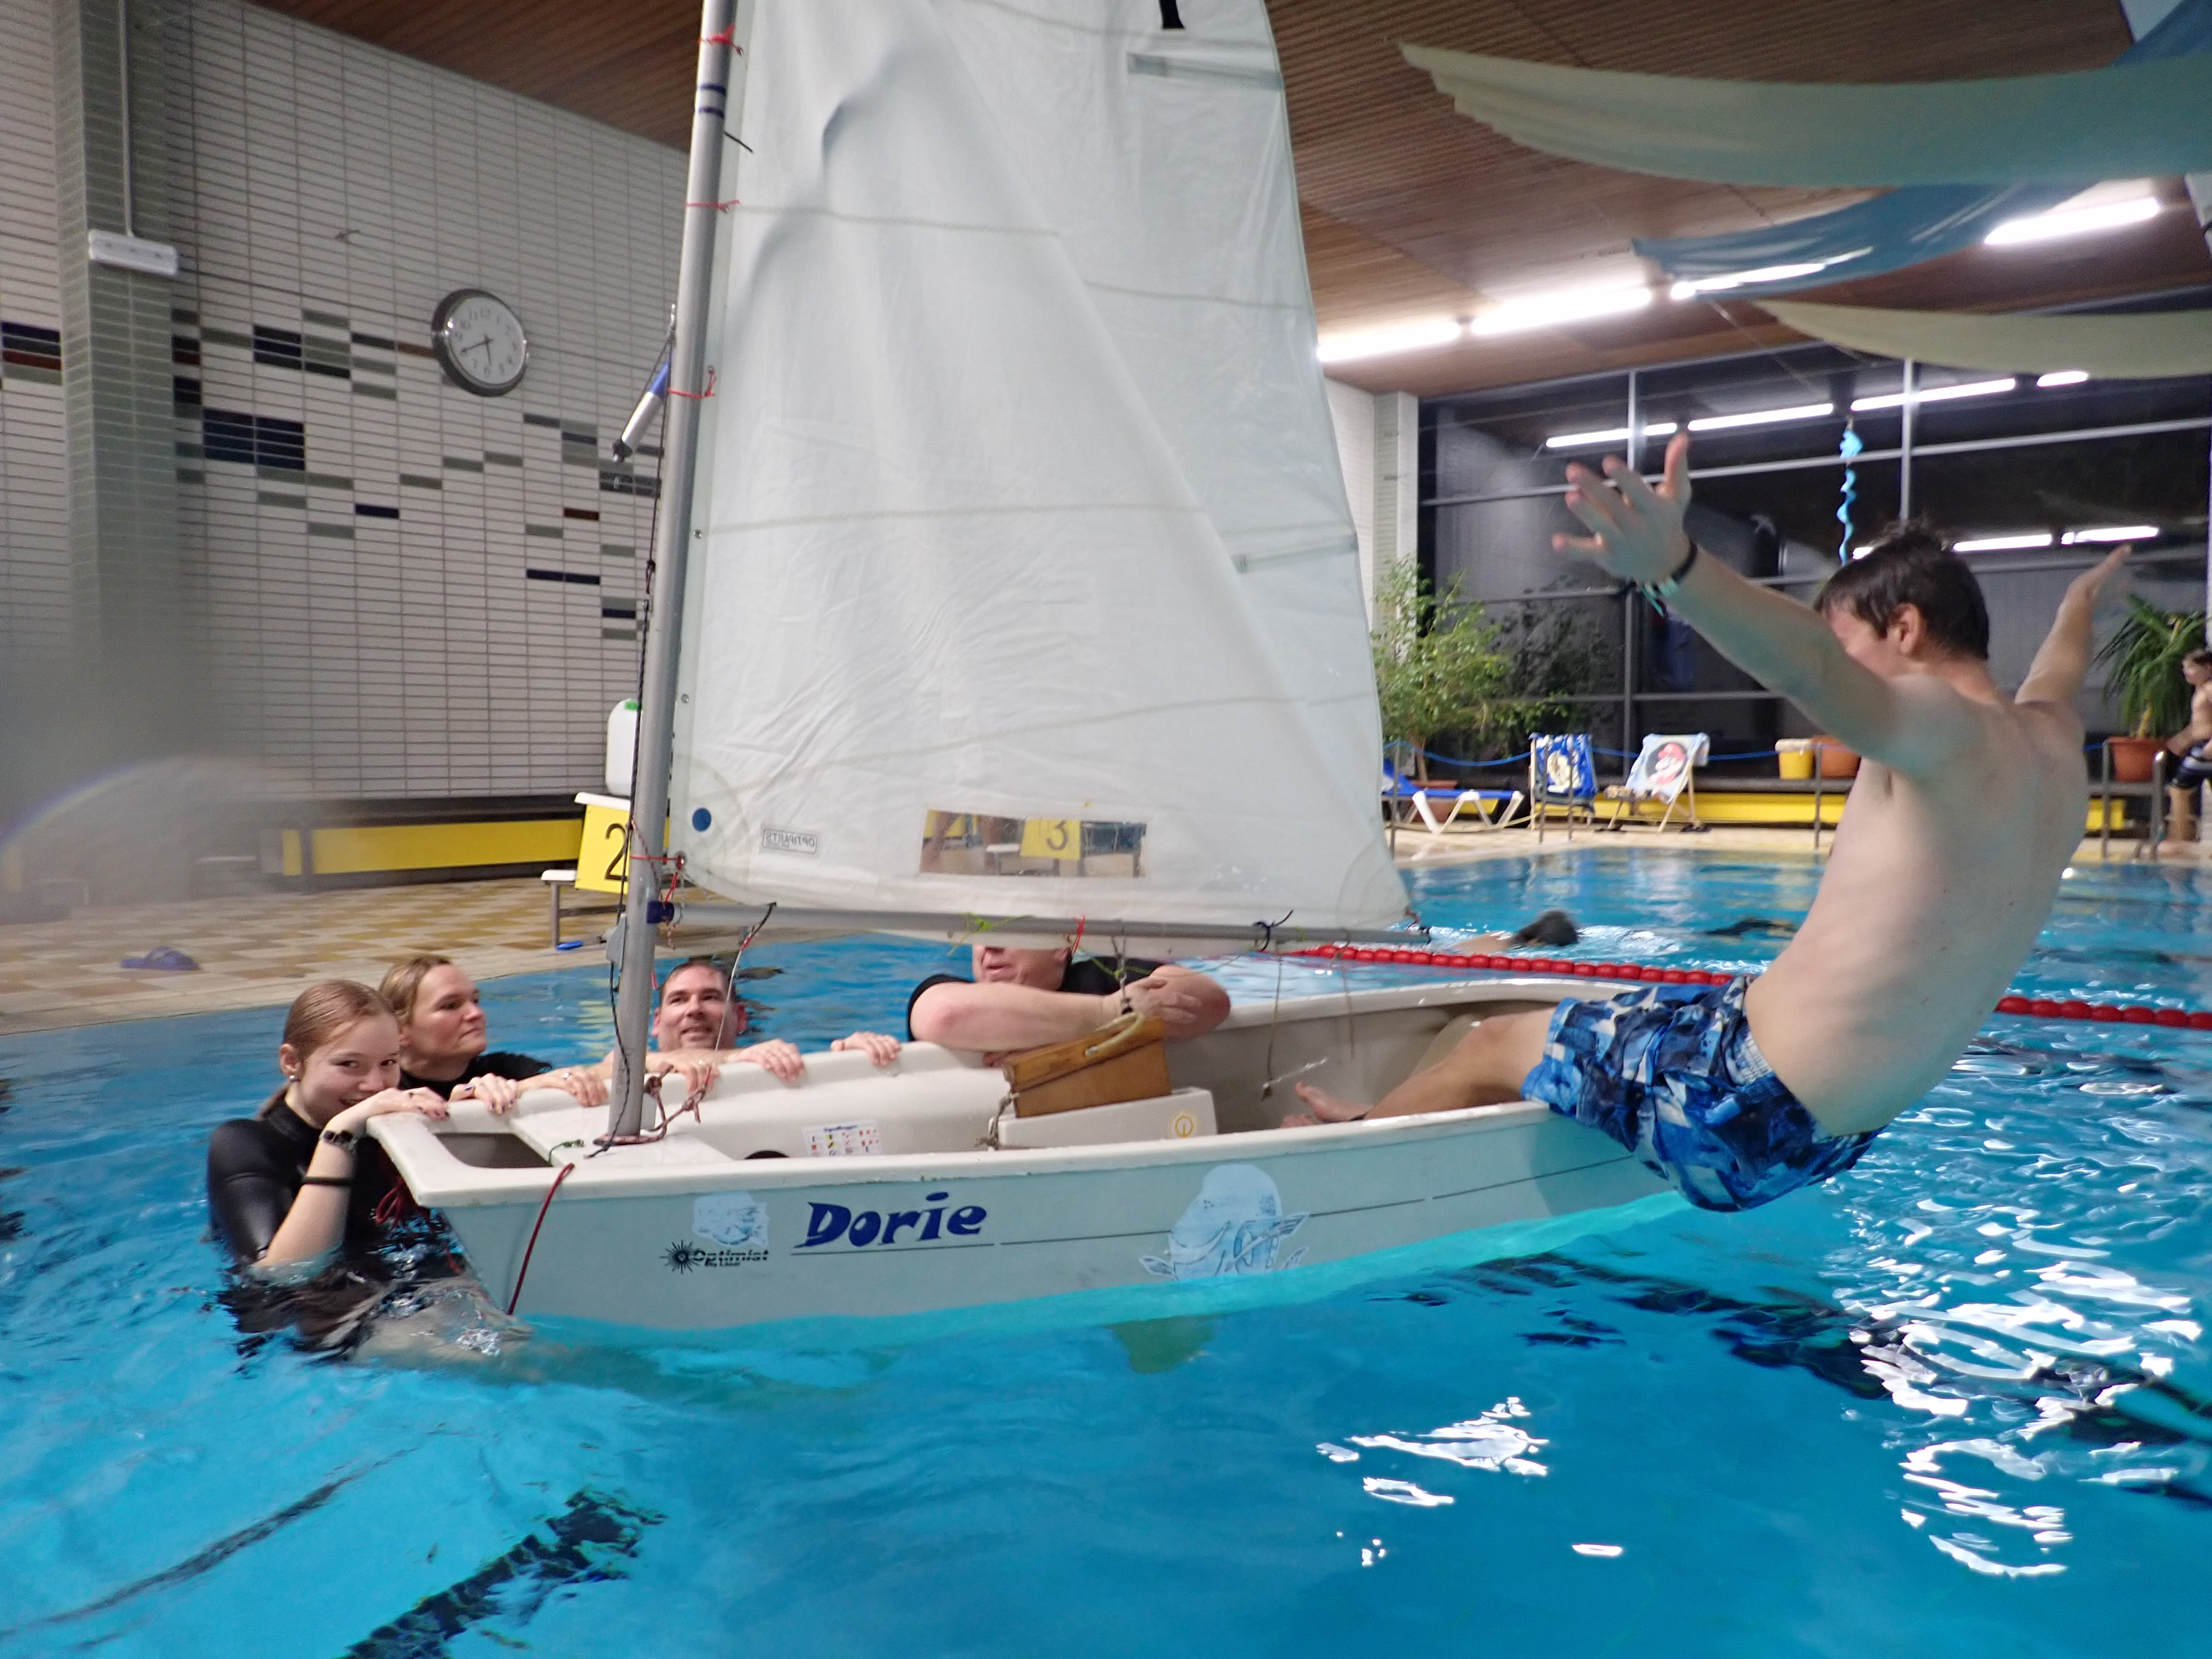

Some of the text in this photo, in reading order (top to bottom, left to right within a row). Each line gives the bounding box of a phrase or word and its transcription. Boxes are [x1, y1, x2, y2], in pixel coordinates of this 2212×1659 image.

[606, 823, 628, 881] 2
[1047, 820, 1068, 851] 3
[794, 1192, 987, 1248] Dorie
[693, 1248, 769, 1266] Optimist
